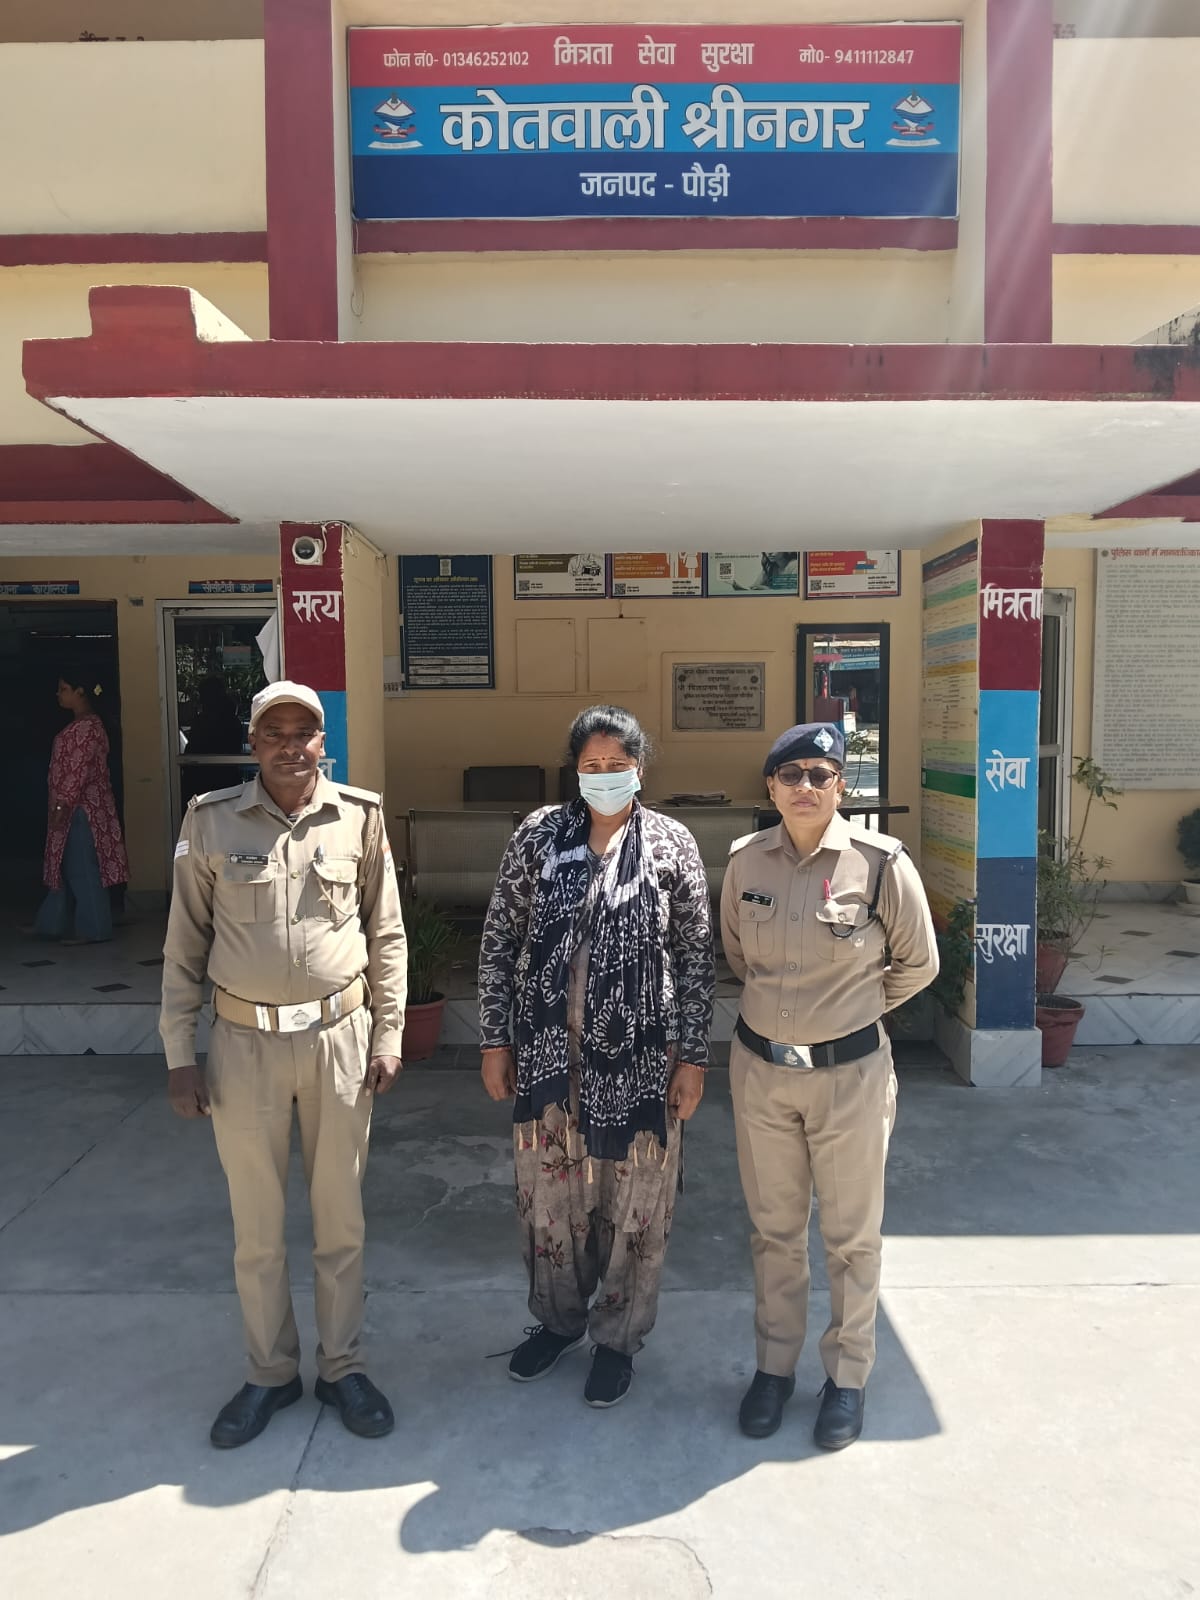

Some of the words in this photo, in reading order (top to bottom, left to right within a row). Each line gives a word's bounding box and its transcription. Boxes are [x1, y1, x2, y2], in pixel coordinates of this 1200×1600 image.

[383, 48, 411, 68] फोन
[443, 51, 529, 67] 01346252102
[553, 36, 614, 66] मित्रता
[637, 35, 677, 65] सेवा
[700, 43, 755, 72] सुरक्षा
[834, 49, 914, 64] 9411112847
[438, 84, 670, 151] कोतवाली
[681, 83, 871, 150] श्रीनगर
[579, 172, 657, 197] जनपद
[681, 161, 731, 203] पौड़ी
[292, 590, 343, 623] सत्य
[980, 583, 1044, 622] मित्रता
[985, 749, 1030, 792] सेवा
[974, 923, 1031, 964] सुरक्षा
